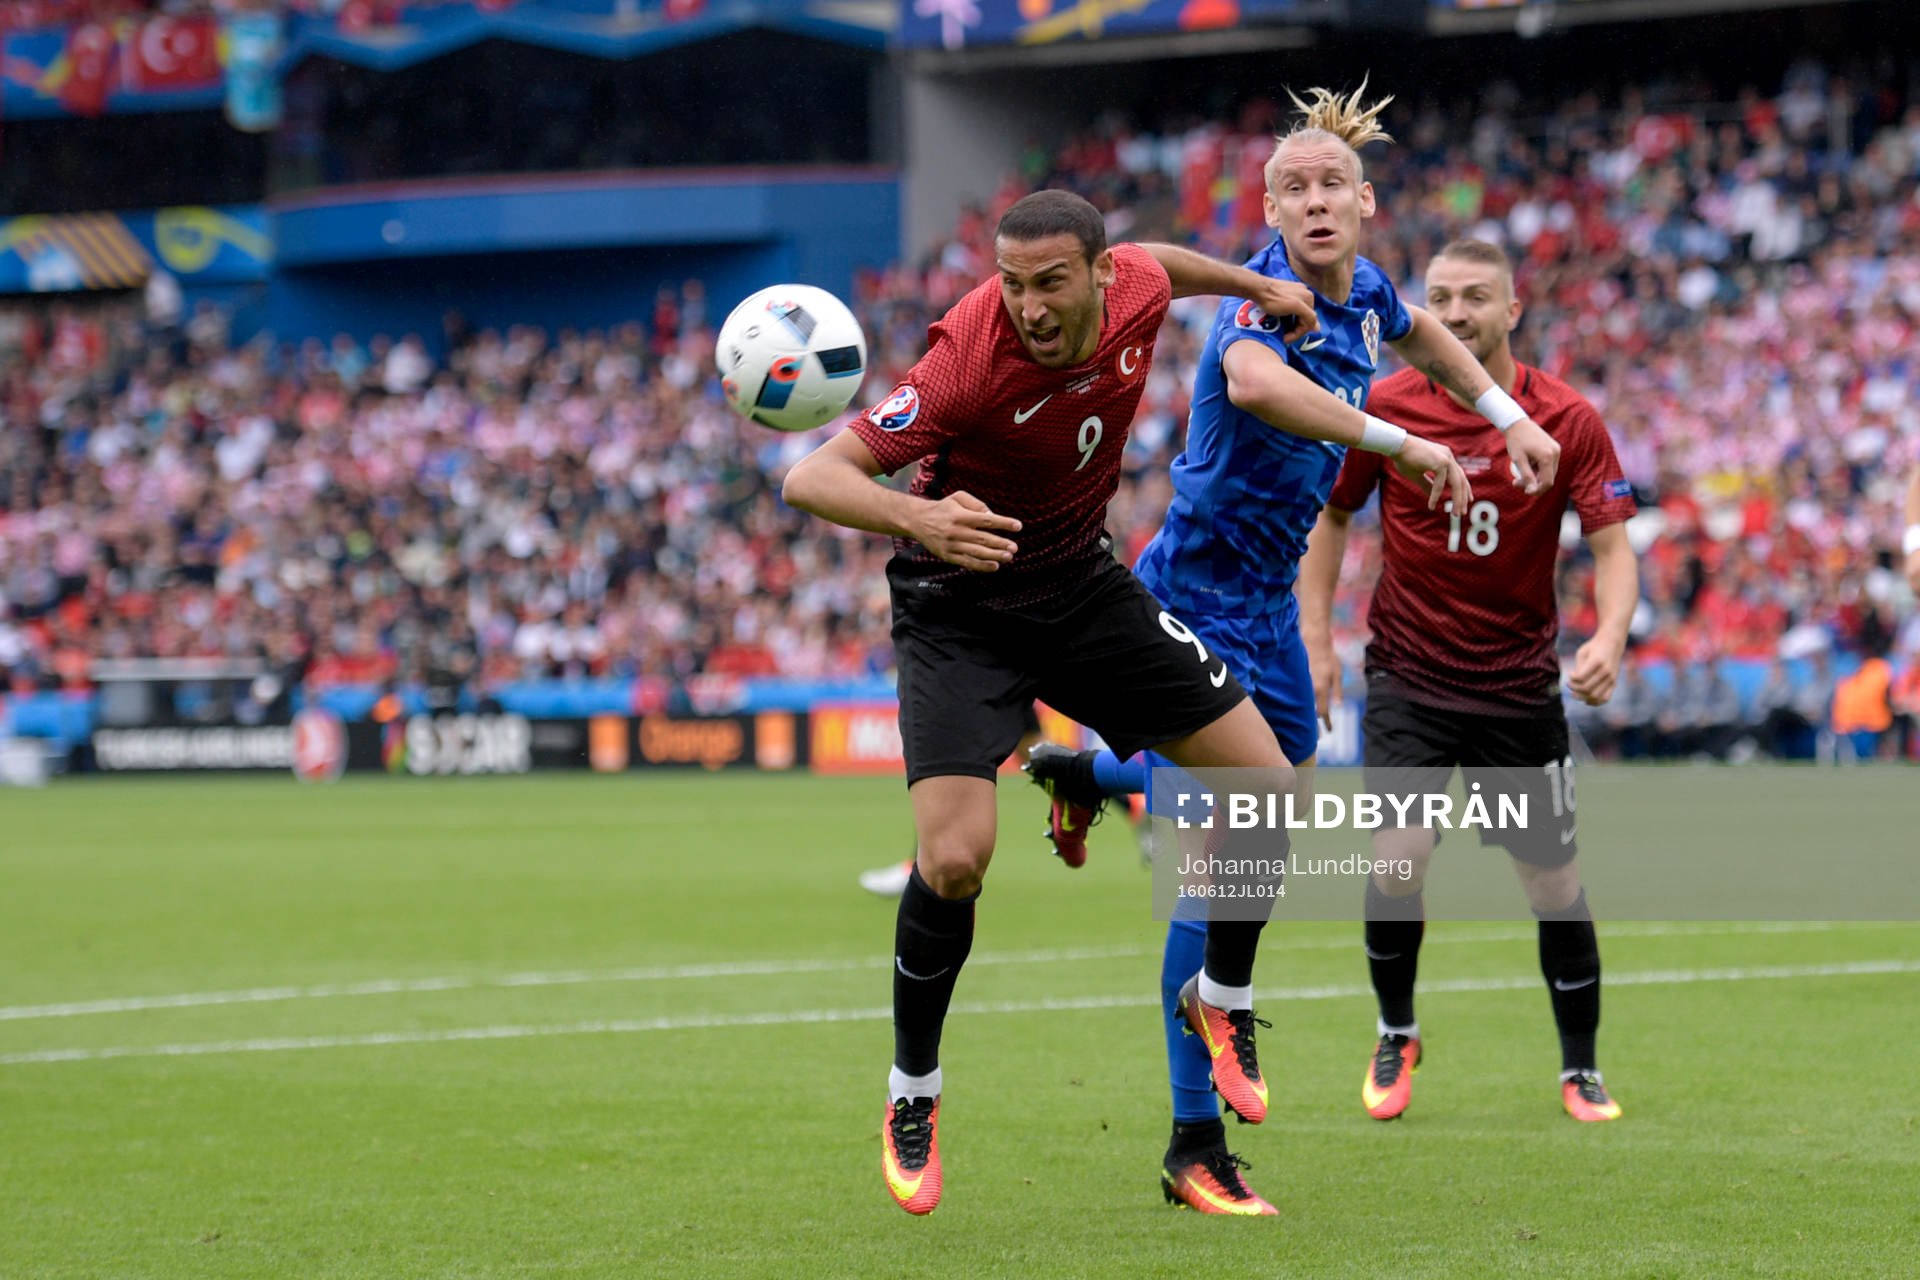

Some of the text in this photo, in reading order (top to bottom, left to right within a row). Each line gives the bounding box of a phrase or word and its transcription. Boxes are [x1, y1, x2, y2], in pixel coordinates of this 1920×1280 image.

[1335, 386, 1362, 410] 1
[1074, 416, 1103, 472] 9
[1444, 500, 1500, 556] 18
[1158, 610, 1208, 663] 9
[639, 712, 744, 771] Orange
